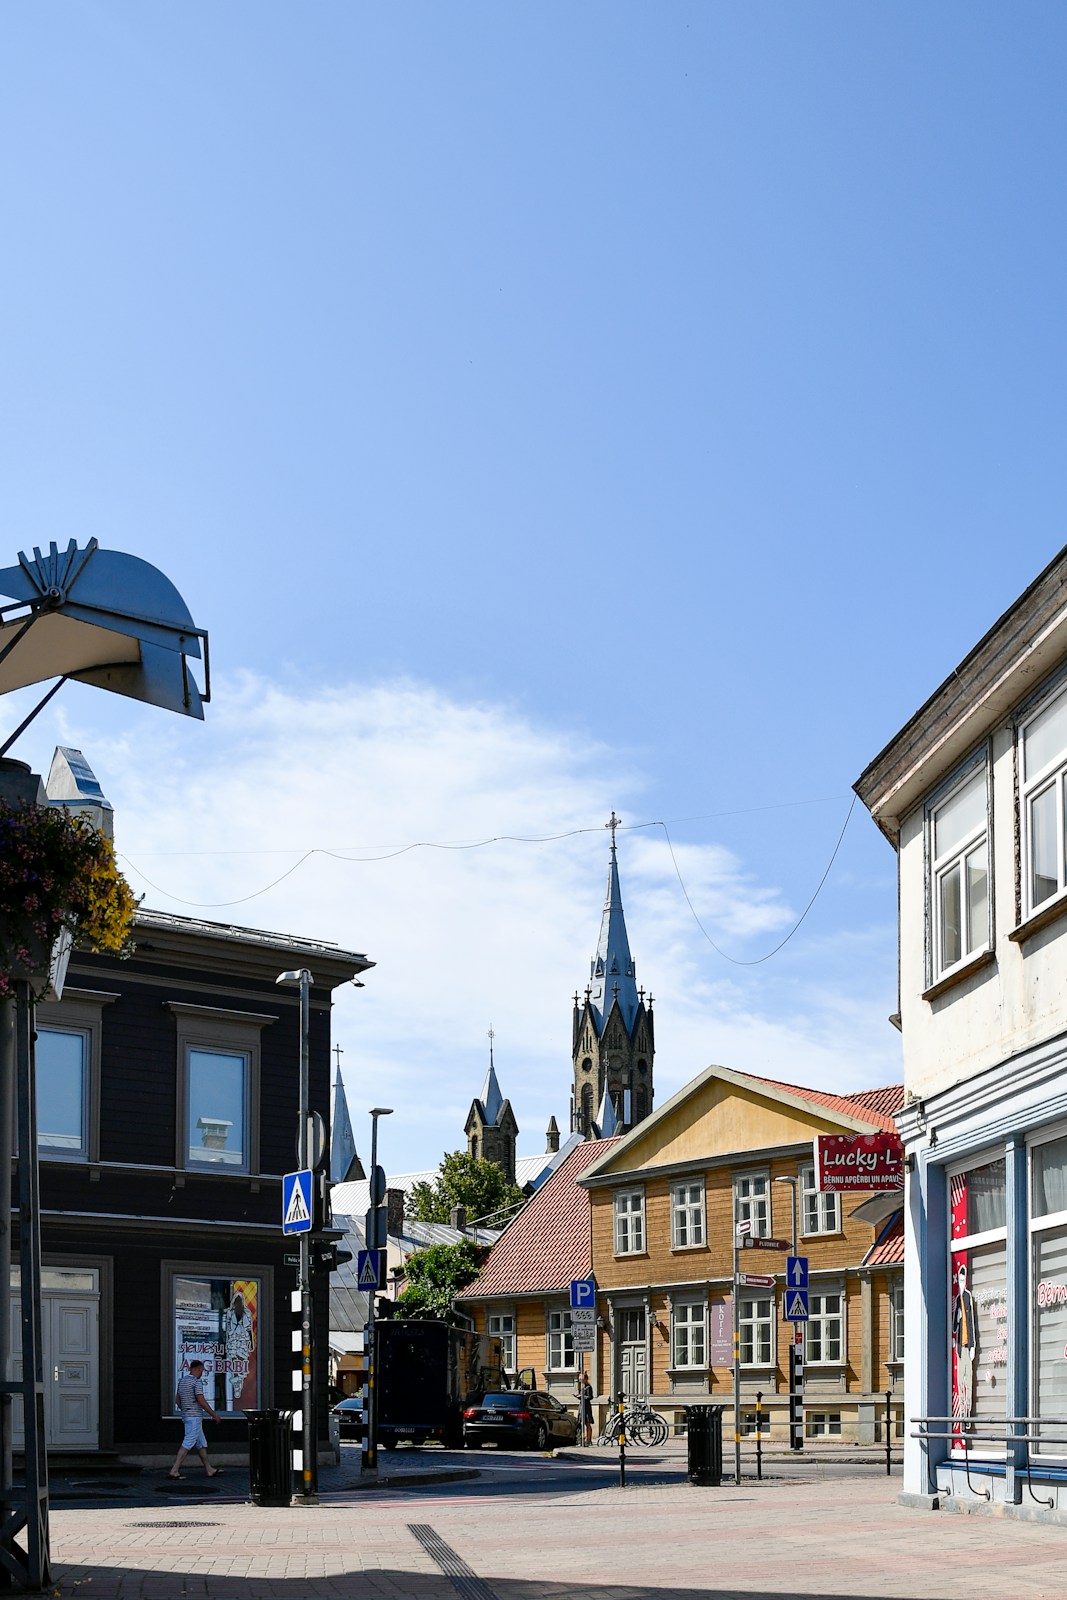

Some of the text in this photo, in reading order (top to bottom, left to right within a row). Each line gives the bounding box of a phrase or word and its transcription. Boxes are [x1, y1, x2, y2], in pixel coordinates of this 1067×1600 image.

[823, 1175, 899, 1185] BĒRNU APĢĒRBI UN APAVI
[577, 1283, 591, 1305] P
[178, 1341, 225, 1356] sieviešu
[180, 1356, 249, 1376] AĢĒRBI
